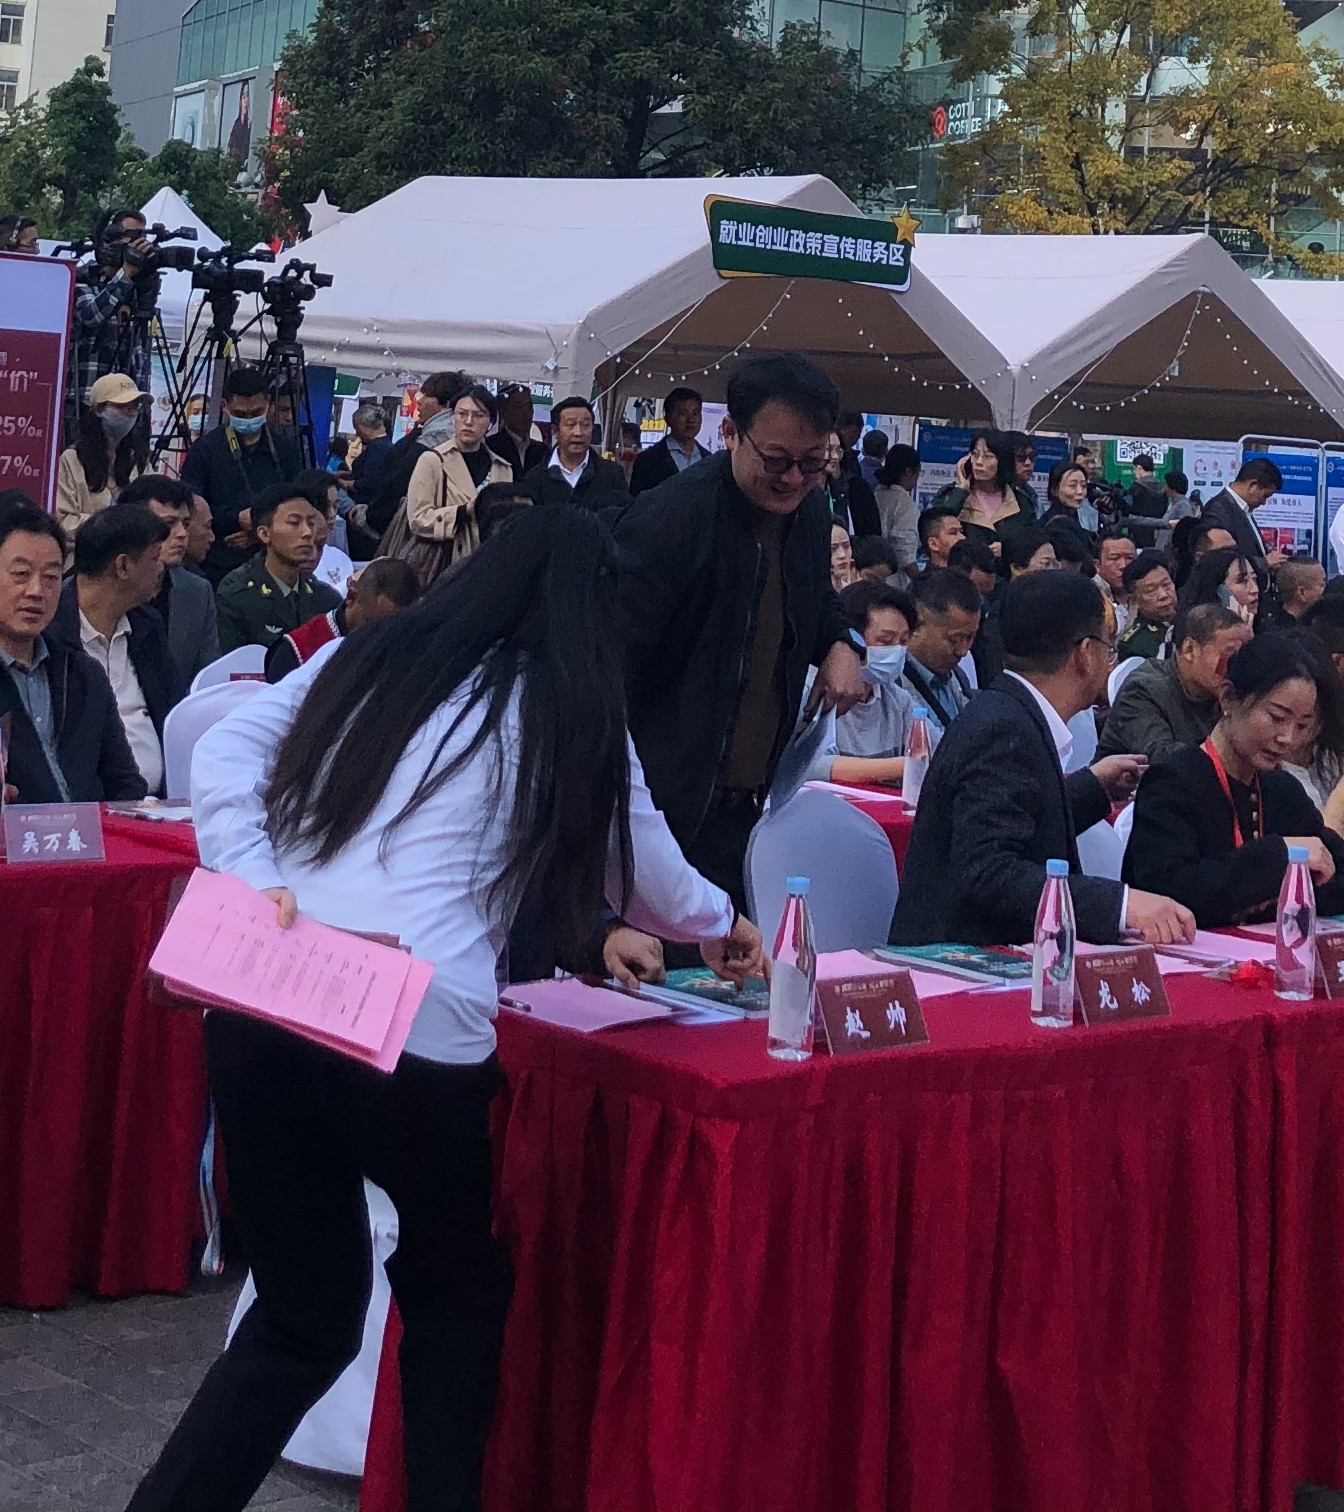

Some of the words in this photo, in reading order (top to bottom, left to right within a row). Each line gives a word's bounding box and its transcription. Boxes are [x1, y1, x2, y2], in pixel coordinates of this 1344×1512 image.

[719, 219, 905, 267] 就业创业政策宣传服务区
